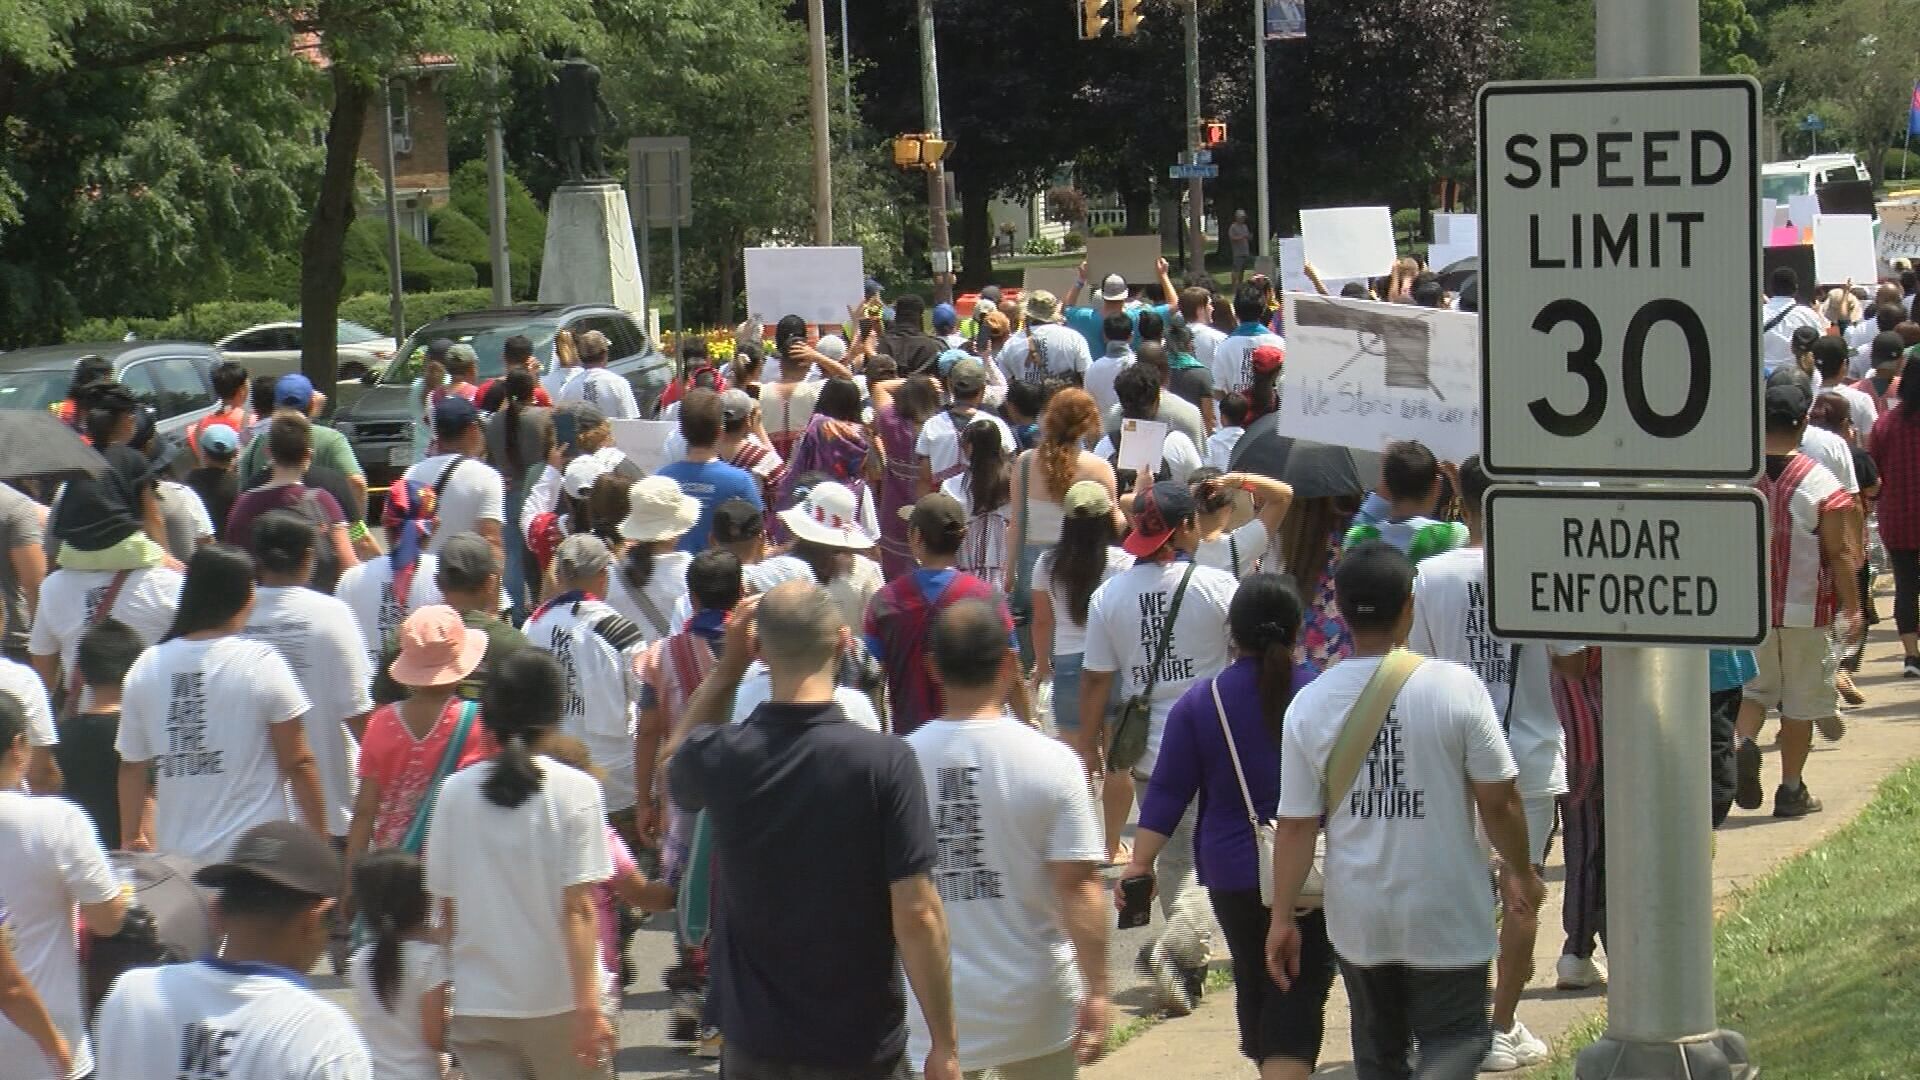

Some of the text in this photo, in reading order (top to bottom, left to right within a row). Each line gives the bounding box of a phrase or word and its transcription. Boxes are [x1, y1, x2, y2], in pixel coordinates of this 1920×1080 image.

[1504, 130, 1732, 188] SPEED
[1529, 211, 1704, 268] LIMIT
[1527, 298, 1711, 438] 30
[1301, 376, 1329, 416] We
[1563, 517, 1680, 560] RADAR
[1139, 591, 1168, 618] WE
[1467, 581, 1486, 608] W
[1530, 571, 1719, 616] ENFORCED
[1466, 634, 1506, 661] THE
[171, 672, 206, 699] WE
[165, 699, 208, 725] ARE
[165, 725, 208, 752] THE
[154, 751, 223, 778] FUTURE
[1367, 757, 1406, 791] THE
[936, 767, 981, 801] WE
[934, 802, 984, 835] ARE
[1350, 789, 1425, 820] FUTURE
[936, 835, 985, 870] THE
[937, 869, 1004, 902] TURE
[180, 1022, 238, 1078] WE
